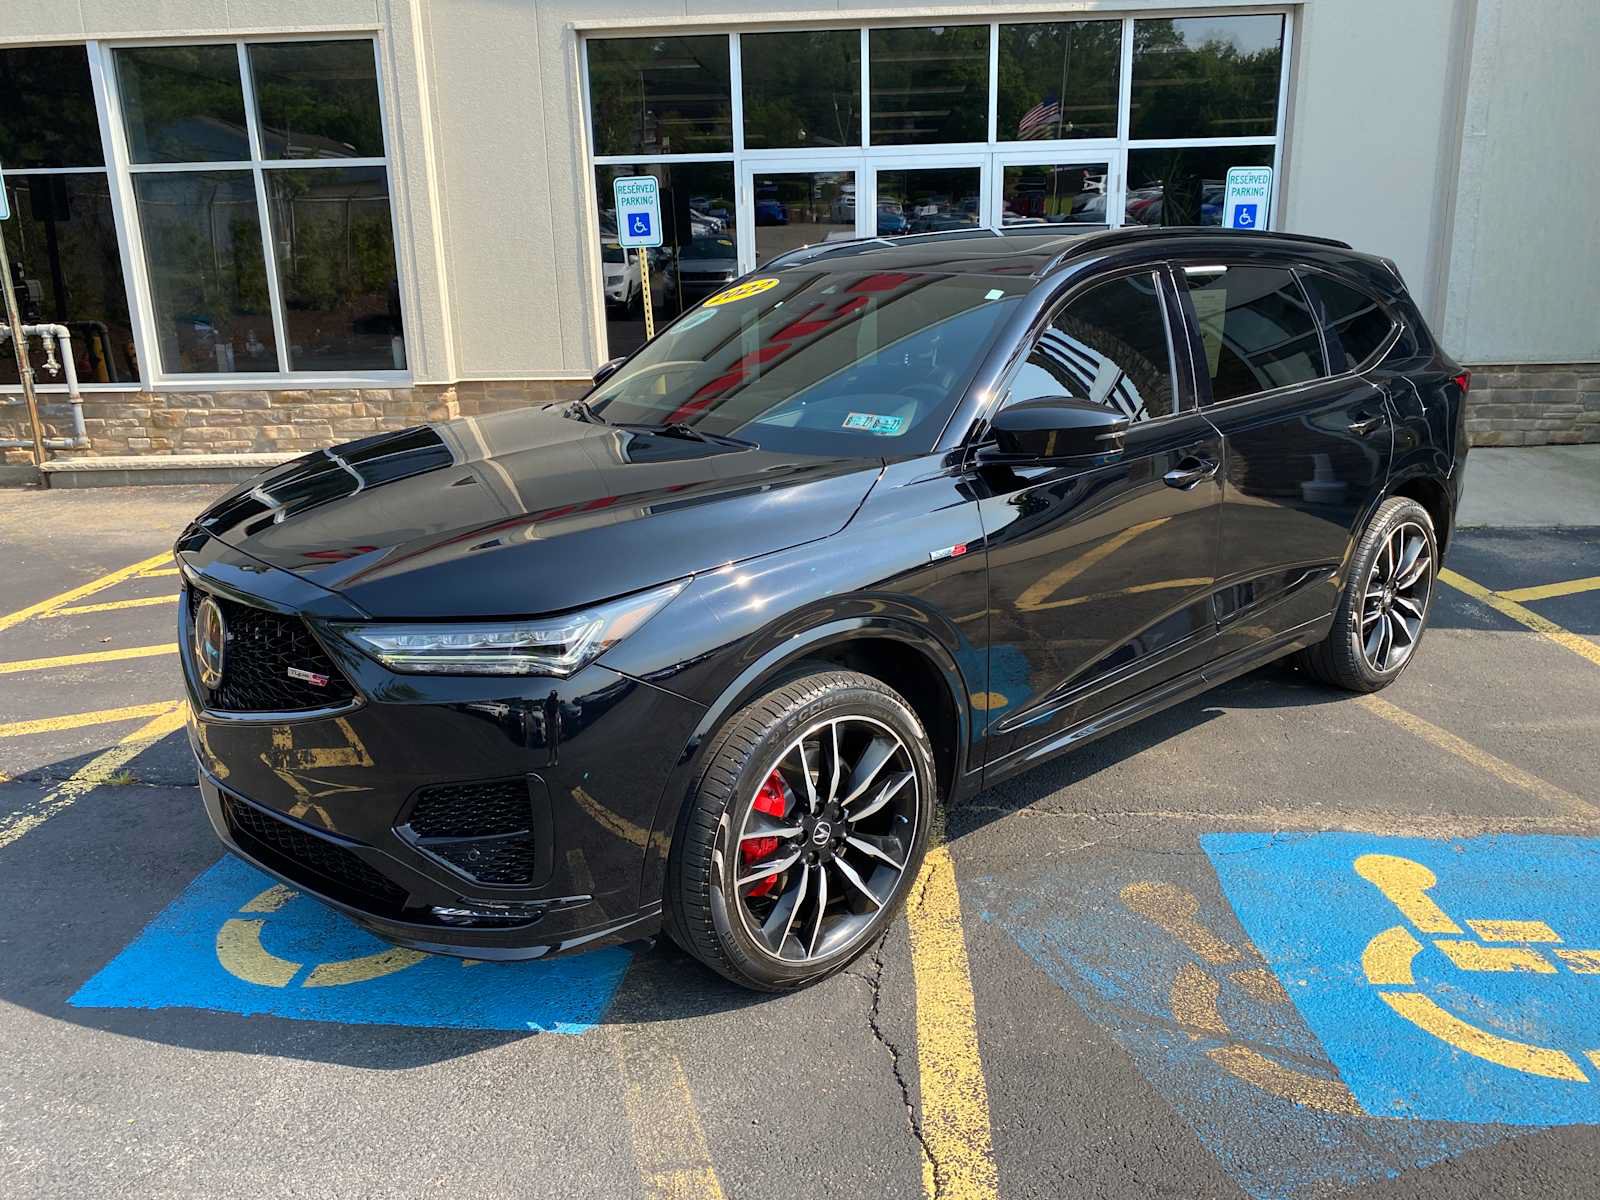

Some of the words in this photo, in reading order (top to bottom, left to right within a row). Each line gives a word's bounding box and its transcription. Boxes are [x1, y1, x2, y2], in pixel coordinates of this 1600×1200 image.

[1230, 175, 1268, 184] RESERVED
[617, 184, 655, 195] RESERVED
[1231, 187, 1264, 197] PARKING
[621, 196, 653, 207] PARKING
